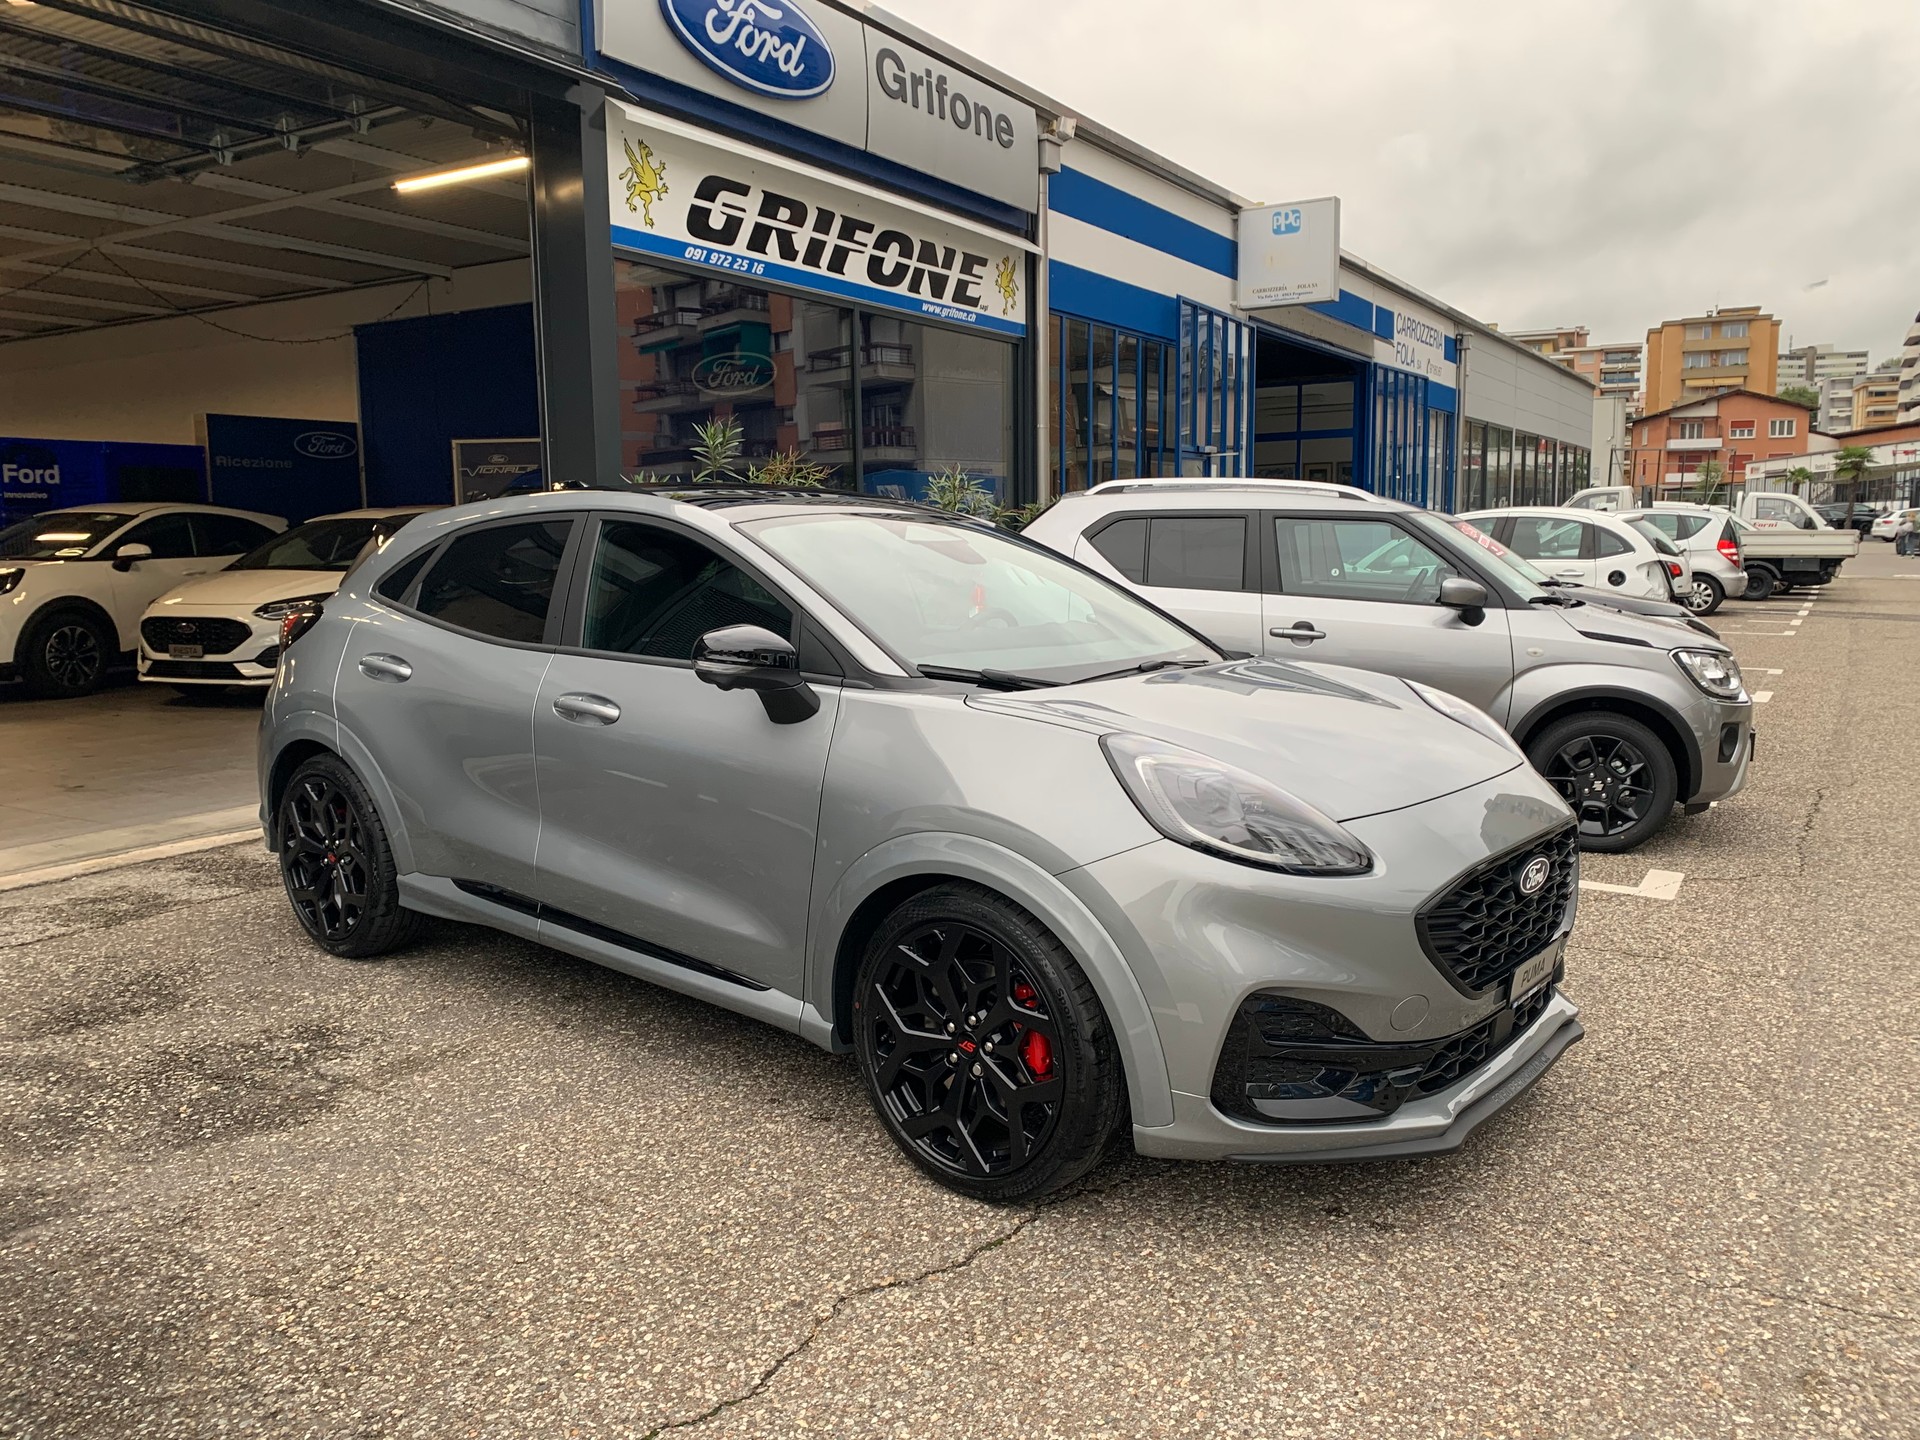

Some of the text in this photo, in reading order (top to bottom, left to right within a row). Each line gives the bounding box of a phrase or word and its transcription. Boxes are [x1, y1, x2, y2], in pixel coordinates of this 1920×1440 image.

[705, 0, 807, 77] Ford
[876, 47, 1015, 149] Grifone
[1273, 209, 1300, 231] PPG
[685, 174, 989, 308] GRIFONE
[684, 246, 766, 275] 091 972 25 16
[921, 302, 977, 323] www.grifone.ch
[1395, 312, 1443, 351] CARROZZERIA
[1395, 341, 1416, 369] FOLA
[708, 358, 761, 388] Ford
[307, 435, 346, 454] Ford
[2, 463, 60, 485] Ford
[215, 455, 293, 469] Ricezione
[1520, 958, 1546, 989] PUMA
[958, 1040, 977, 1053] ST
